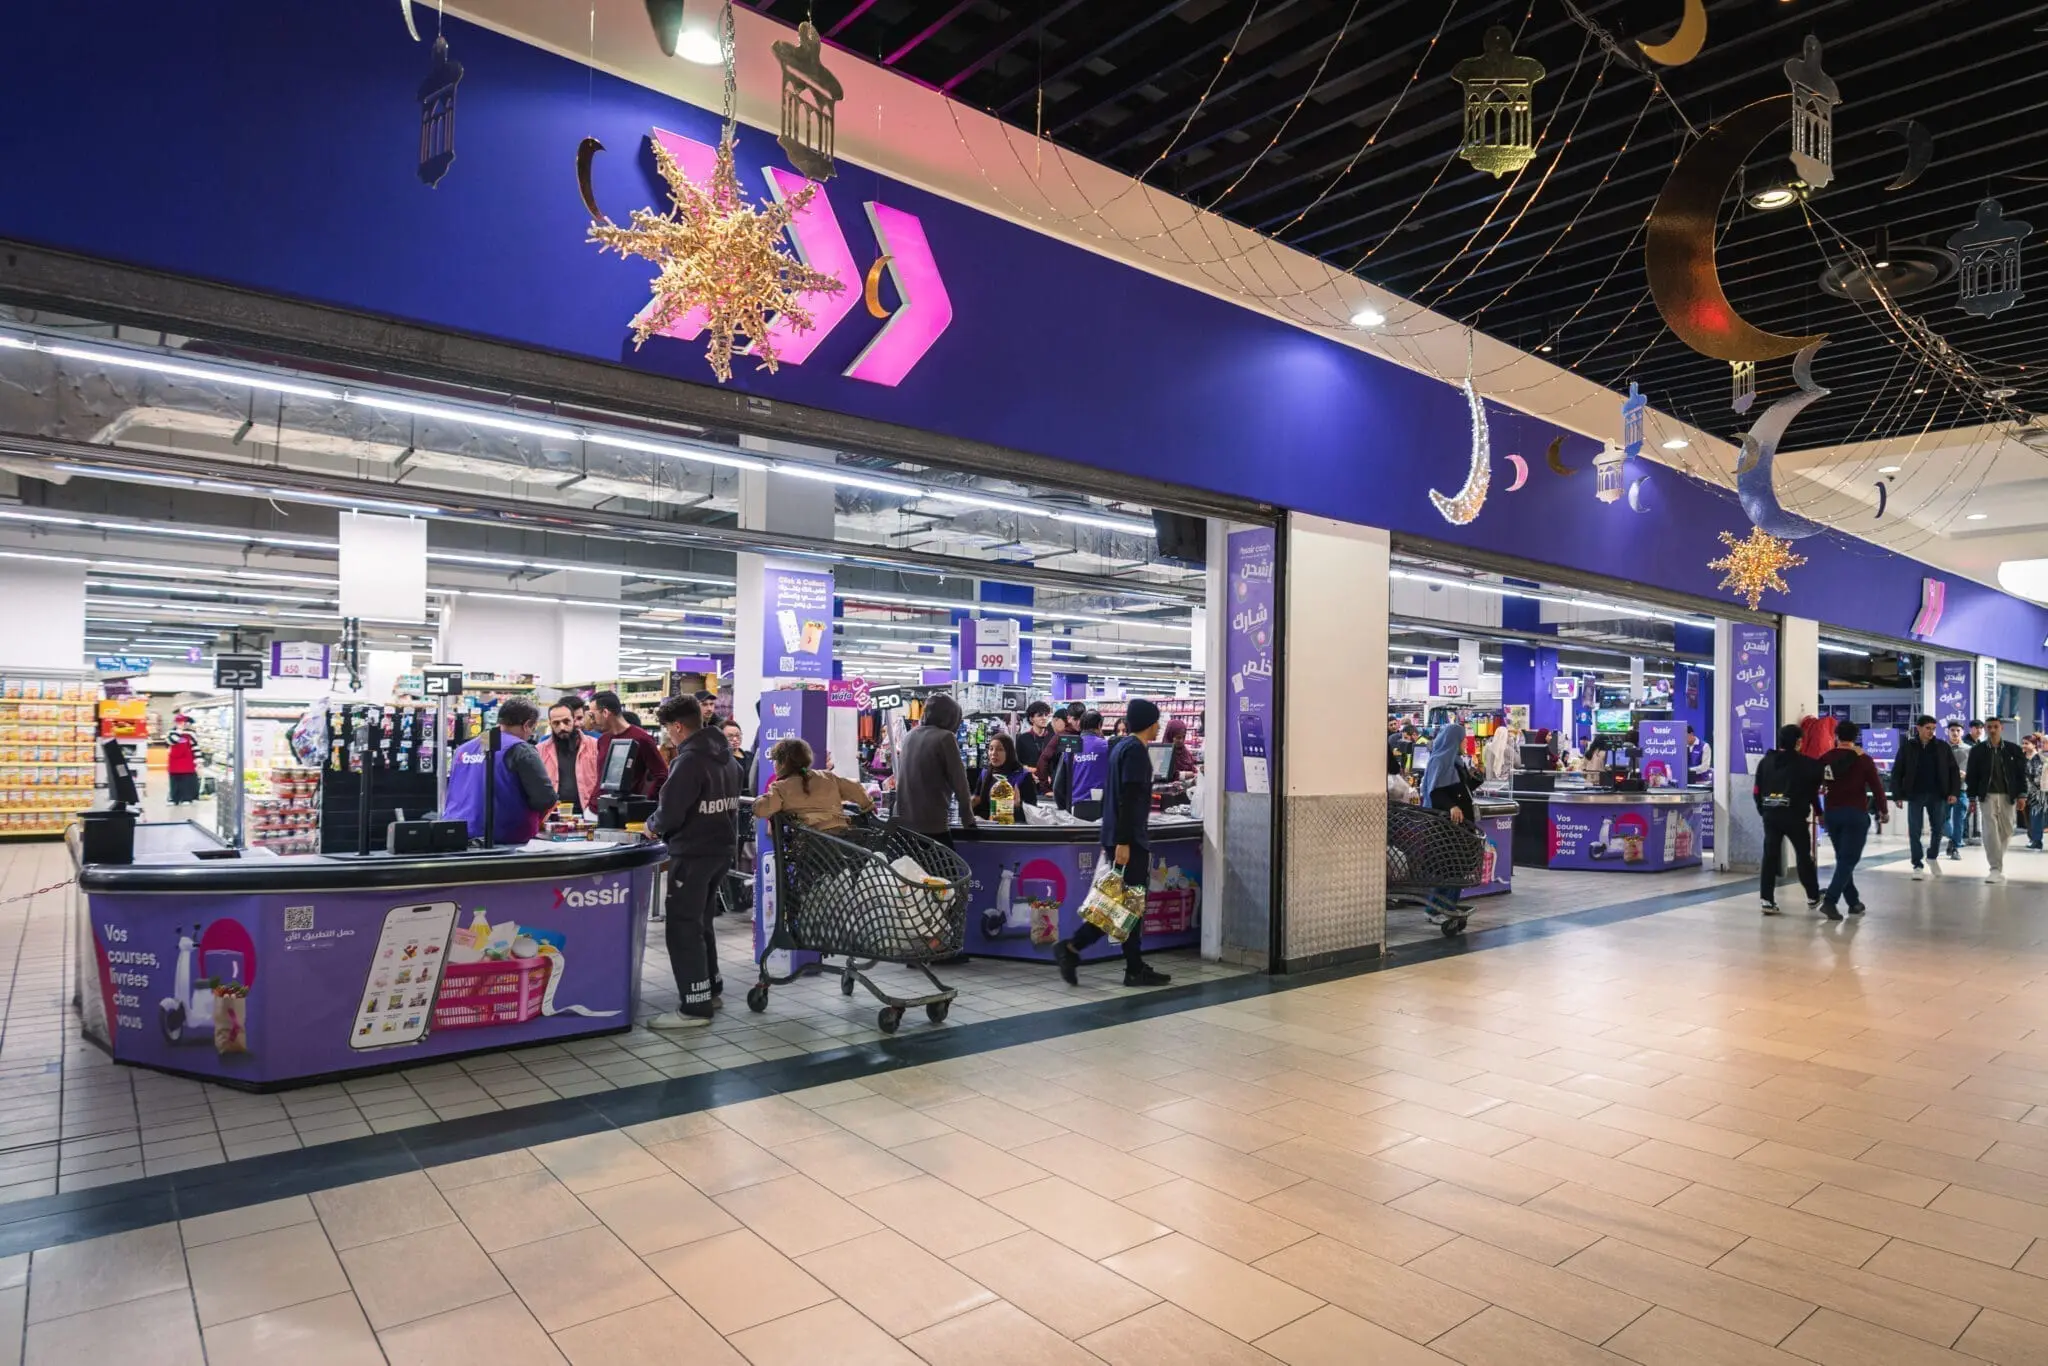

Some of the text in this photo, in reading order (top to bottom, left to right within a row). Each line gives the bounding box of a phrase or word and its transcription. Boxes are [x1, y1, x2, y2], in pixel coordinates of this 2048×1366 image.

[981, 654, 1003, 667] 999
[220, 669, 257, 686] 22
[426, 677, 449, 693] 21
[1003, 697, 1017, 709] 19
[1556, 814, 1571, 822] Vos
[1556, 824, 1591, 832] courses,
[1556, 831, 1583, 839] livrées
[552, 882, 630, 909] Yassir
[104, 924, 128, 942] Vos
[108, 950, 160, 969] courses,
[109, 967, 149, 988] livrées
[112, 990, 140, 1008] chez
[116, 1014, 143, 1030] vous
